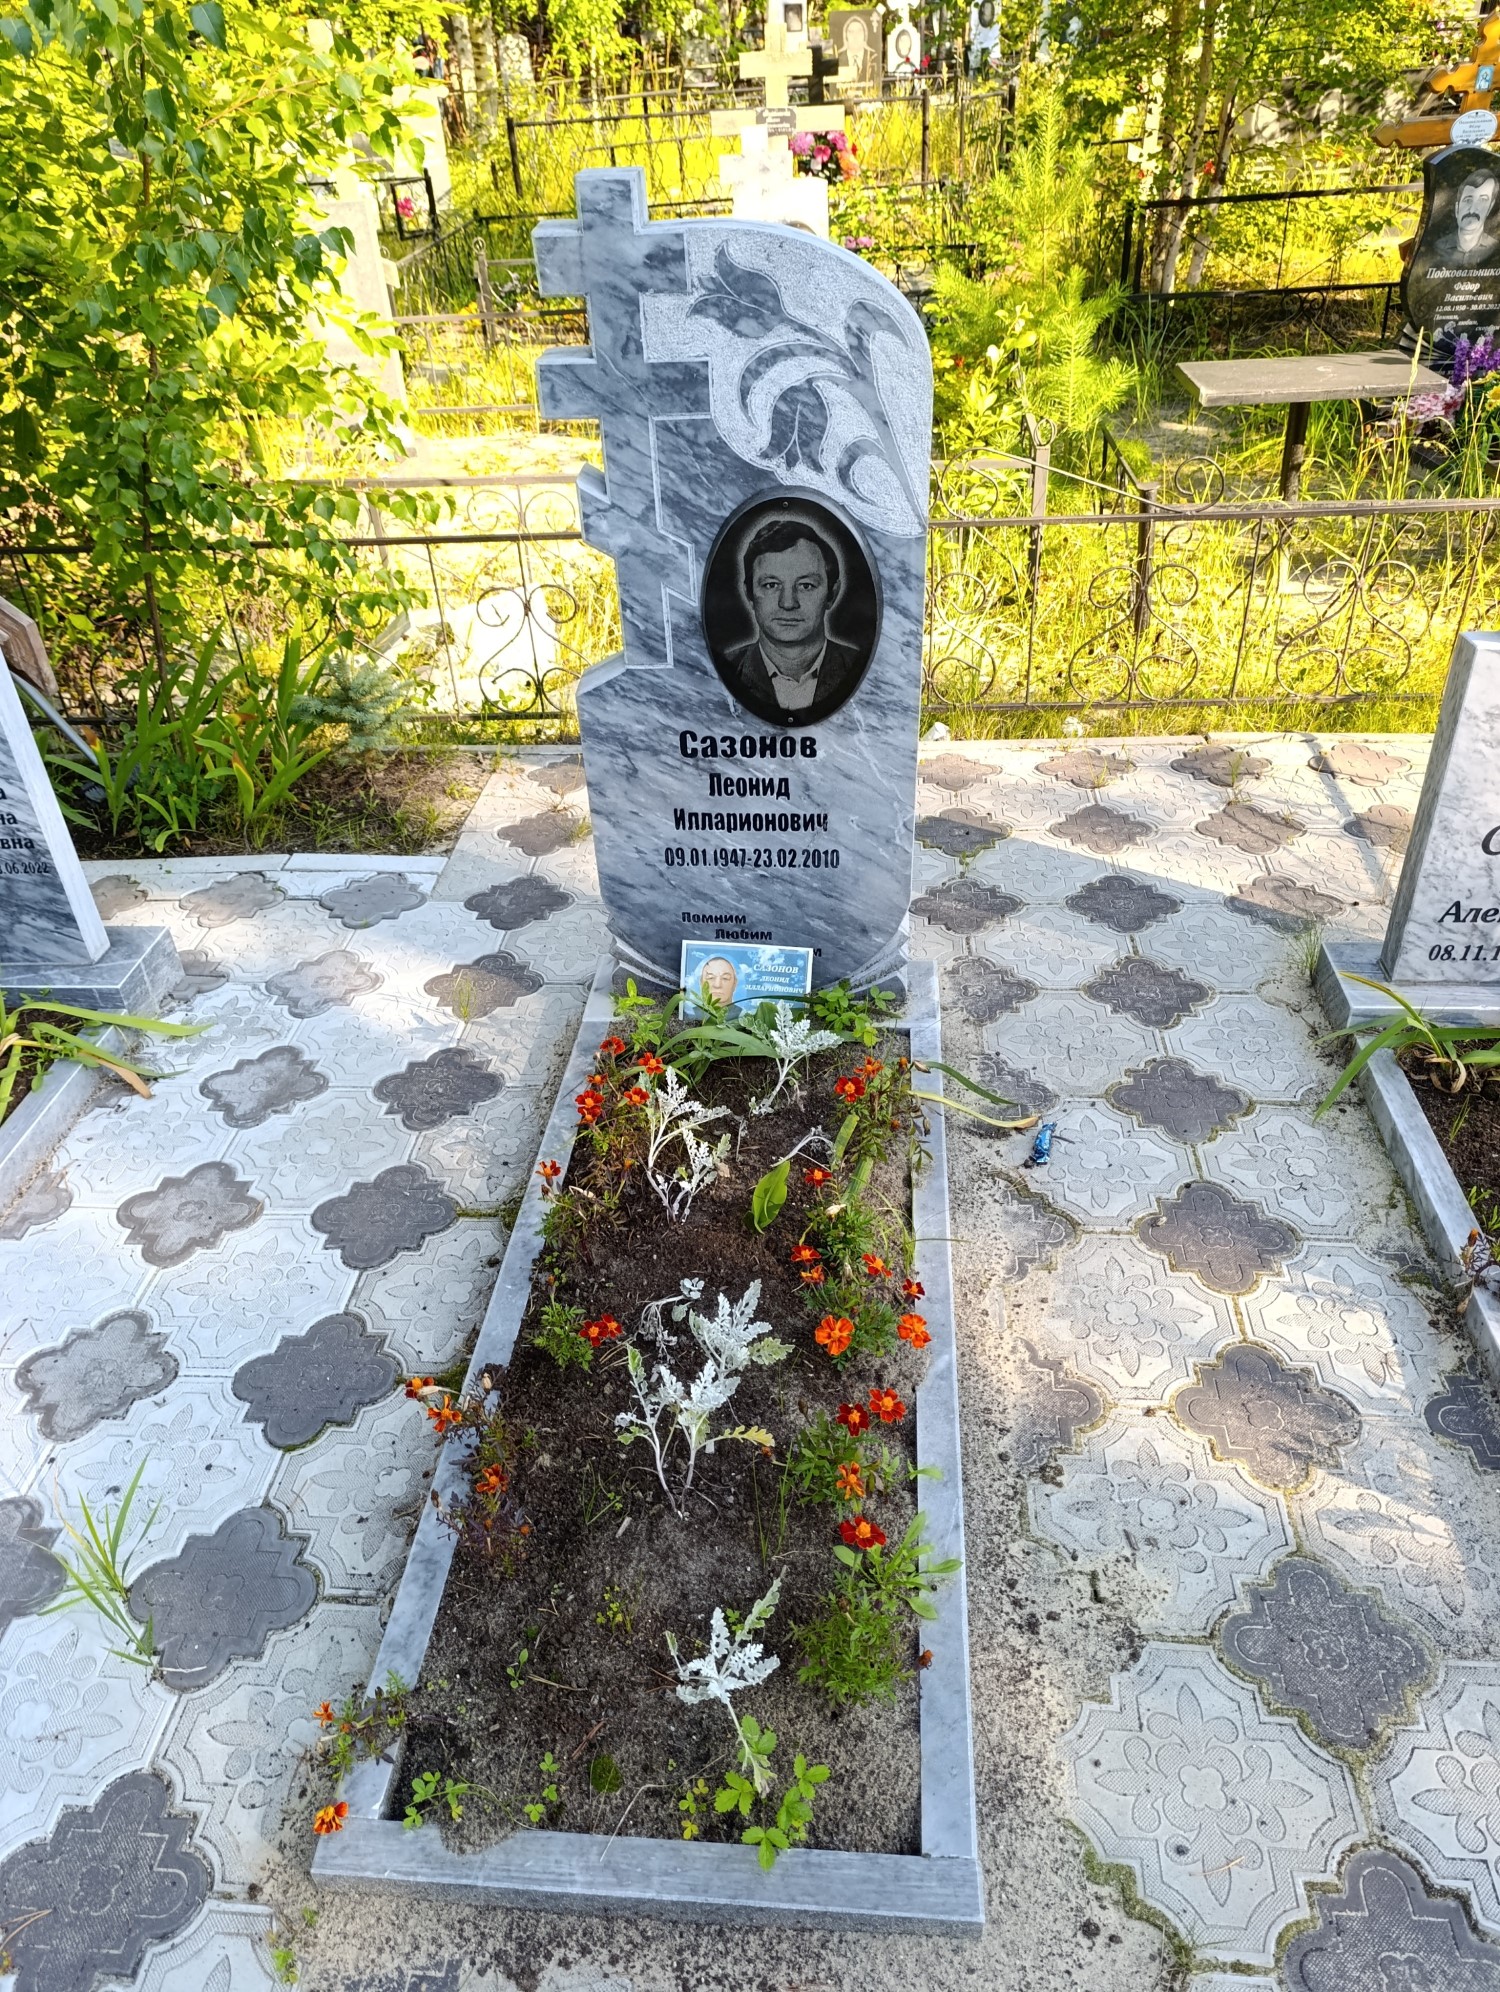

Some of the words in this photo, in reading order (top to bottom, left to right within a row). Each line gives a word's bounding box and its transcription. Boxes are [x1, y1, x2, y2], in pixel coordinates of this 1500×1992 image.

[679, 730, 817, 759] Сазонов
[709, 773, 790, 800] Леонид
[673, 808, 828, 833] Илларионович
[664, 847, 840, 868] 09.01.1947-23.02.2010
[681, 912, 747, 924] Помним
[1437, 900, 1500, 923] Але
[715, 929, 773, 941] Любим
[753, 963, 799, 974] САЗОНОВ
[760, 975, 790, 984] ЛЕОНИД
